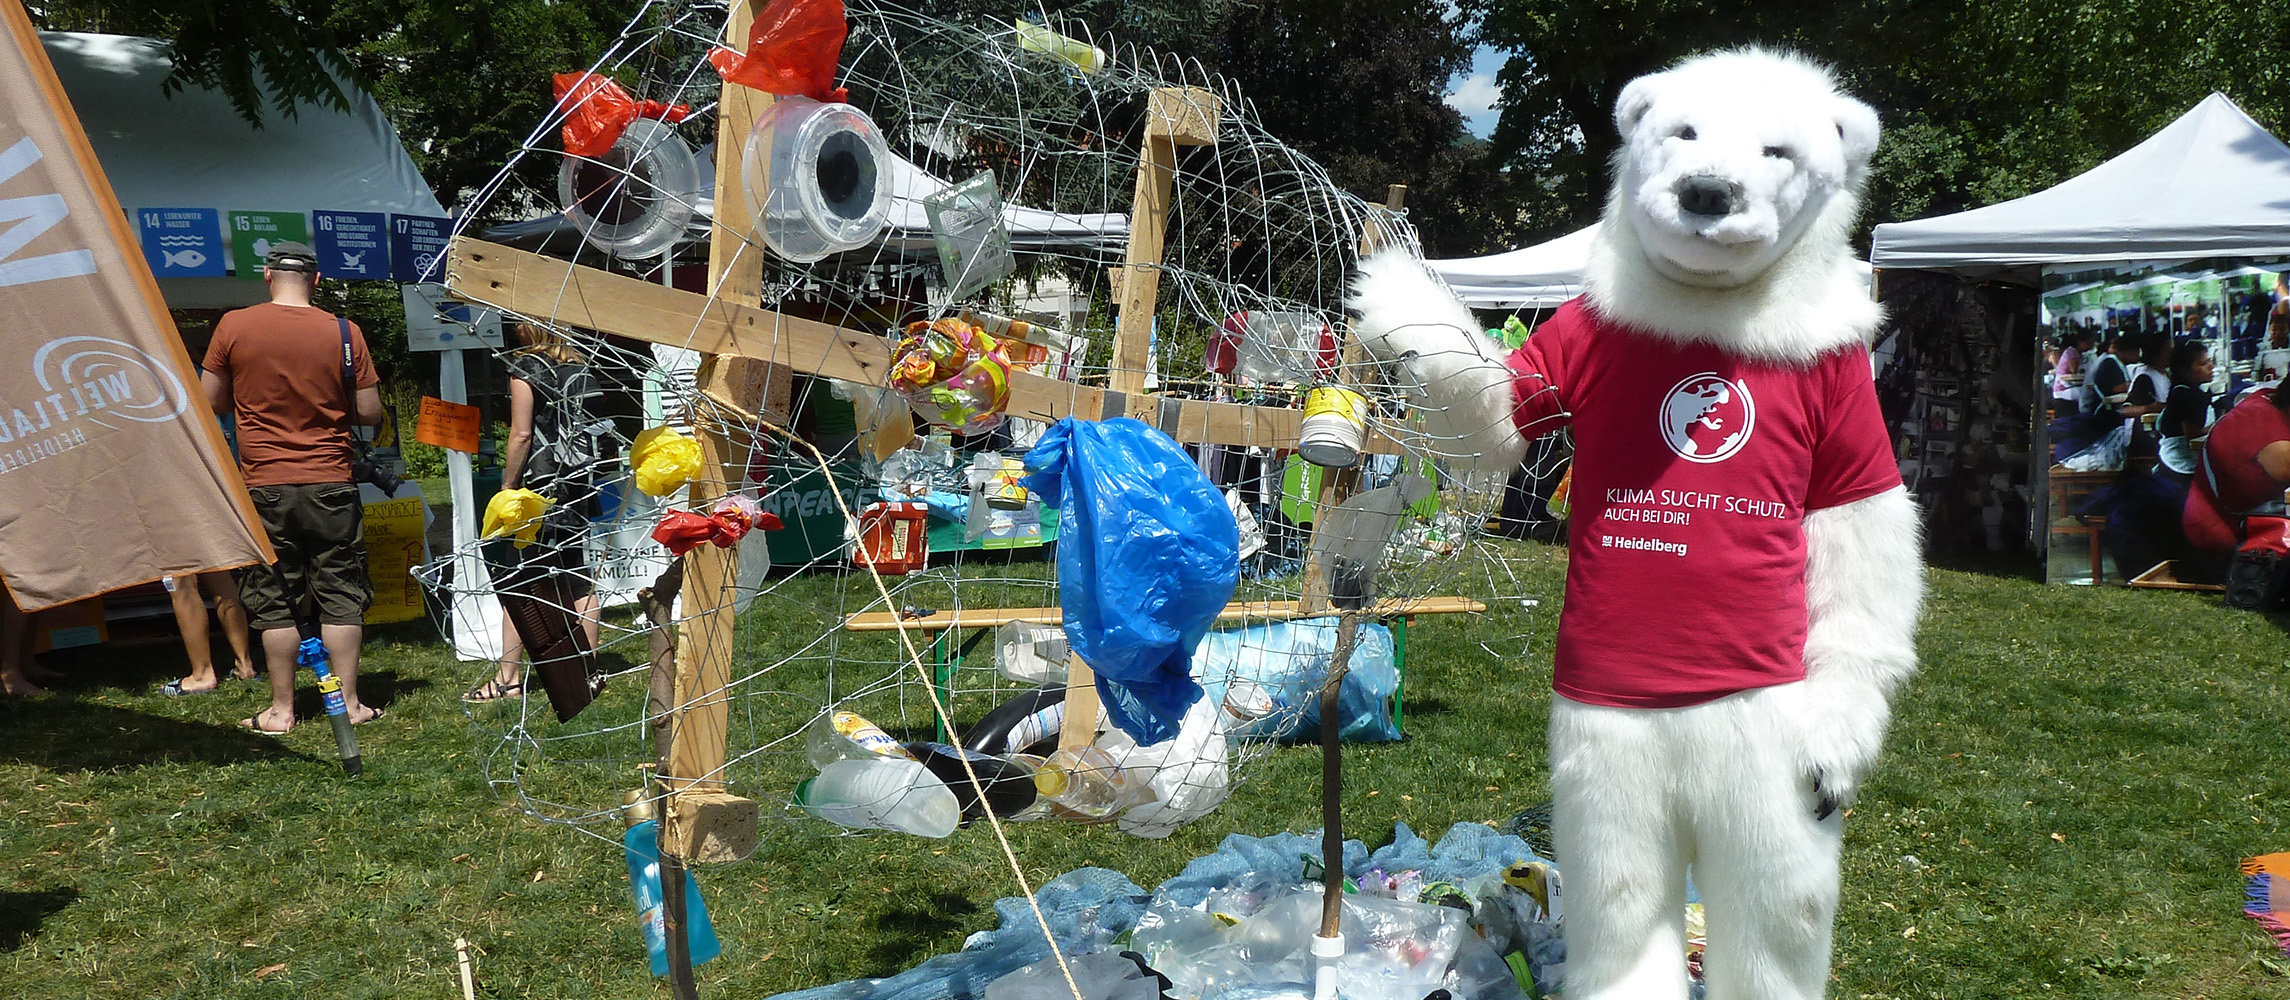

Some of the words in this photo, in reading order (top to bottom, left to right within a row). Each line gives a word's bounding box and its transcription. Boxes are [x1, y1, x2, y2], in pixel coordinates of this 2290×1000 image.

[144, 213, 161, 228] 14
[235, 216, 250, 231] 15
[318, 215, 333, 231] 16
[396, 219, 409, 234] 17
[412, 228, 439, 236] SCHAFTEN
[344, 343, 352, 366] Canon
[1606, 488, 1656, 504] KLIMA
[1660, 489, 1722, 510] SUCHT
[1724, 496, 1786, 519] SCHUTZ
[1603, 508, 1639, 522] AUCH
[1642, 510, 1660, 523] BEI
[1663, 511, 1690, 526] DIR!
[1615, 536, 1688, 556] Heidelberg
